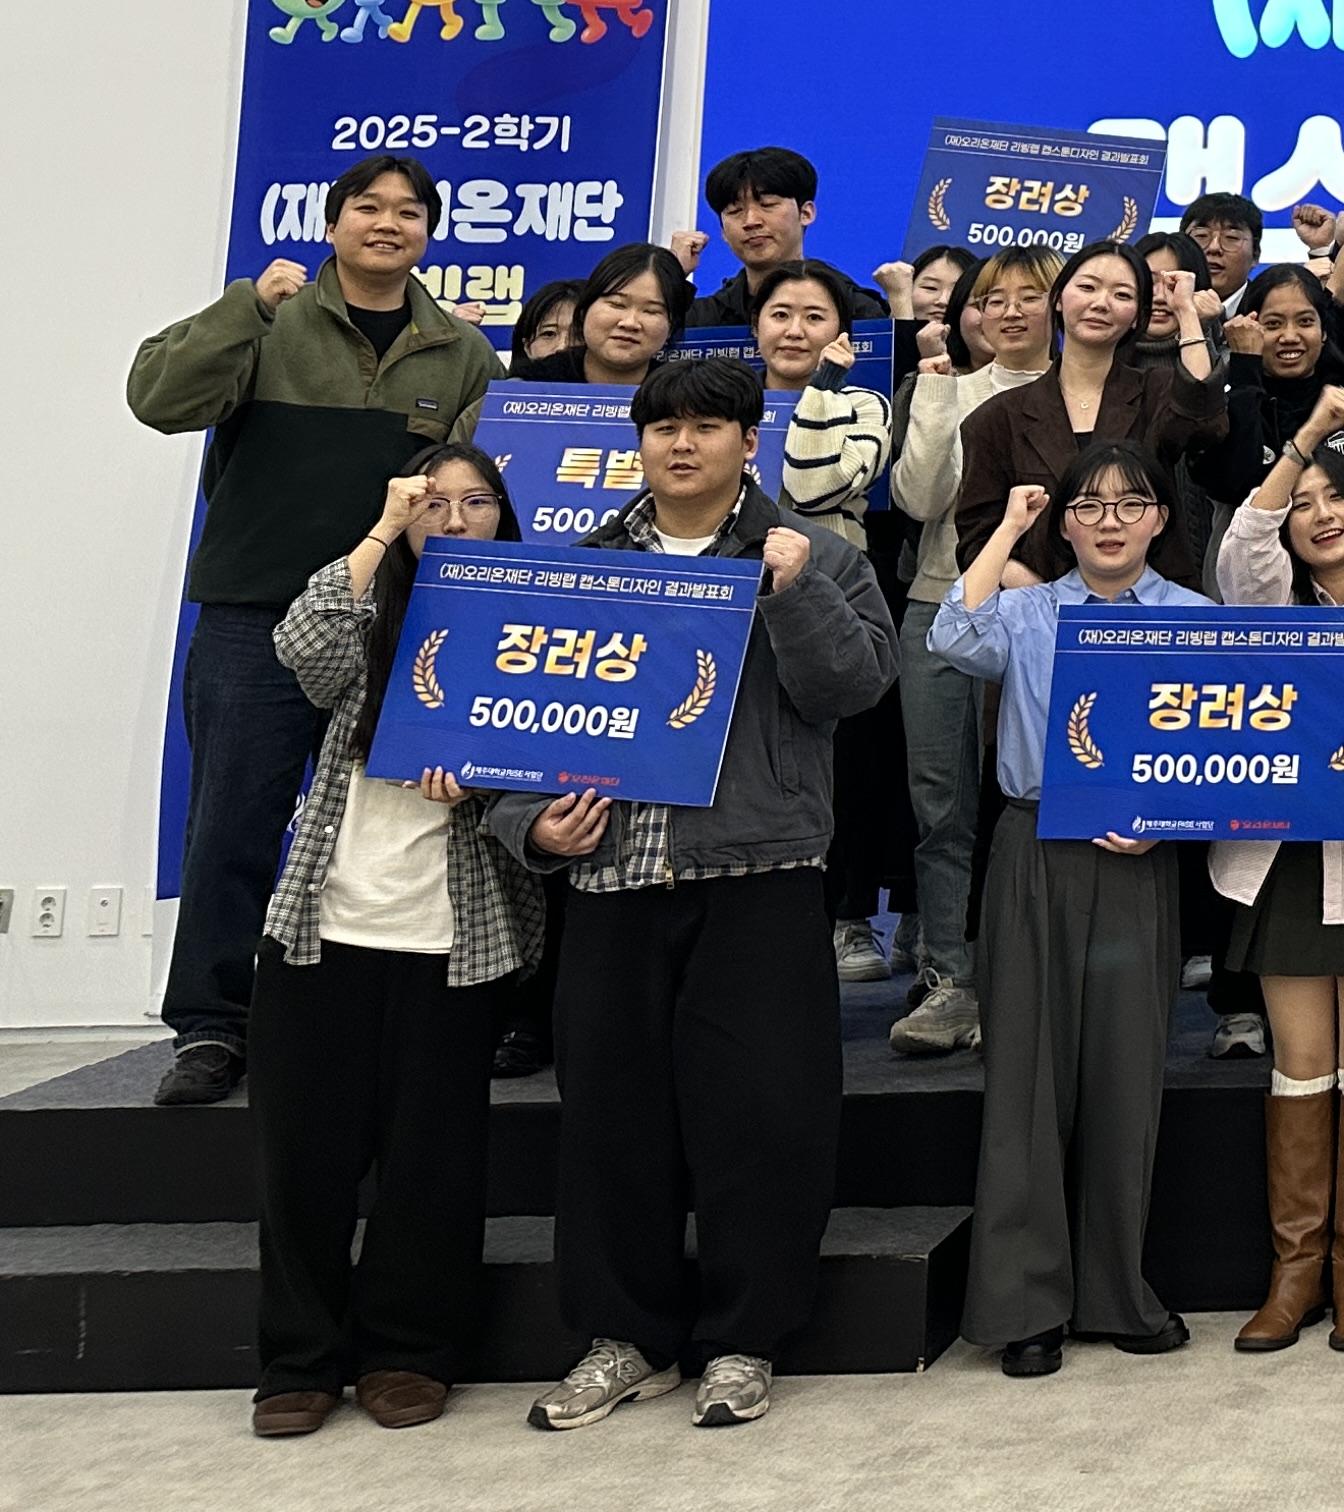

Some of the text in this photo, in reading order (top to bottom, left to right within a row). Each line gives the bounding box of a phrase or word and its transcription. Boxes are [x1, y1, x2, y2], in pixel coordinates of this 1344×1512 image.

[332, 113, 571, 153] 2025-2학기
[984, 175, 1090, 218] 장려상
[555, 447, 645, 490] 특별
[495, 623, 648, 683] 장려상
[469, 696, 640, 739] 500,000원
[1148, 682, 1298, 732] 장려상
[1131, 753, 1300, 786] 500,000원
